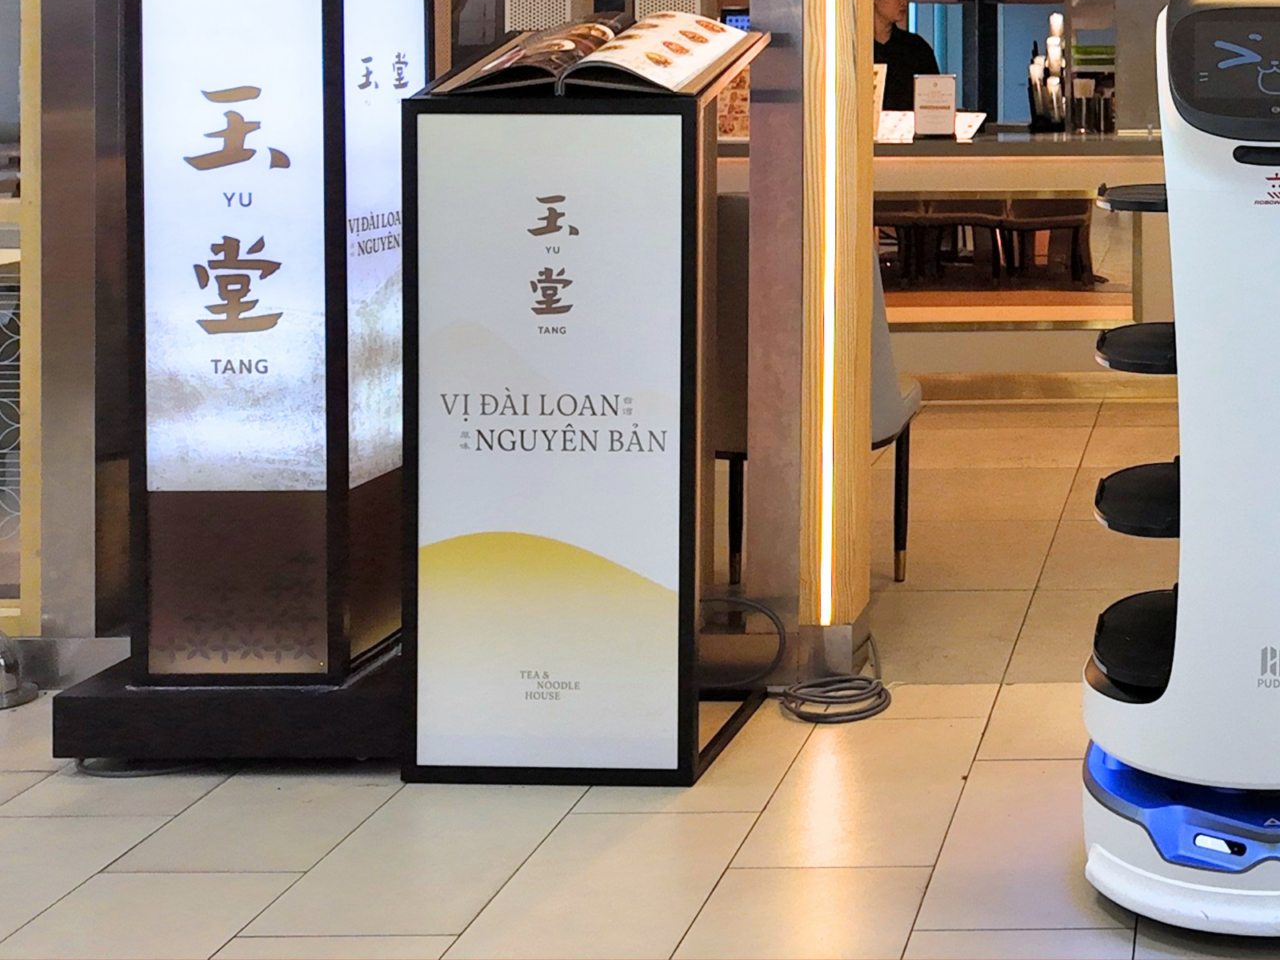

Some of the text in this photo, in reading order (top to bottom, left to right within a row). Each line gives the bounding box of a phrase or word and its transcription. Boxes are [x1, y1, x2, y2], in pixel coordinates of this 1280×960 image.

[392, 52, 409, 89] 堂
[183, 86, 291, 171] 玉
[223, 192, 252, 207] YU
[361, 211, 379, 232] ĐÀI
[382, 211, 402, 227] LOA
[527, 195, 579, 236] 玉
[357, 231, 400, 256] NGUYÊN
[545, 246, 560, 254] YU
[193, 235, 283, 334] 堂
[530, 267, 573, 315] 堂
[538, 326, 566, 334] TANG
[211, 359, 268, 374] TANG
[440, 387, 620, 422] VỊ ĐÀI LOAN
[476, 423, 667, 452] NGUYÊN BẢN
[520, 671, 540, 679] TEA
[537, 681, 580, 690] NOODLE
[525, 691, 560, 700] HOUSE
